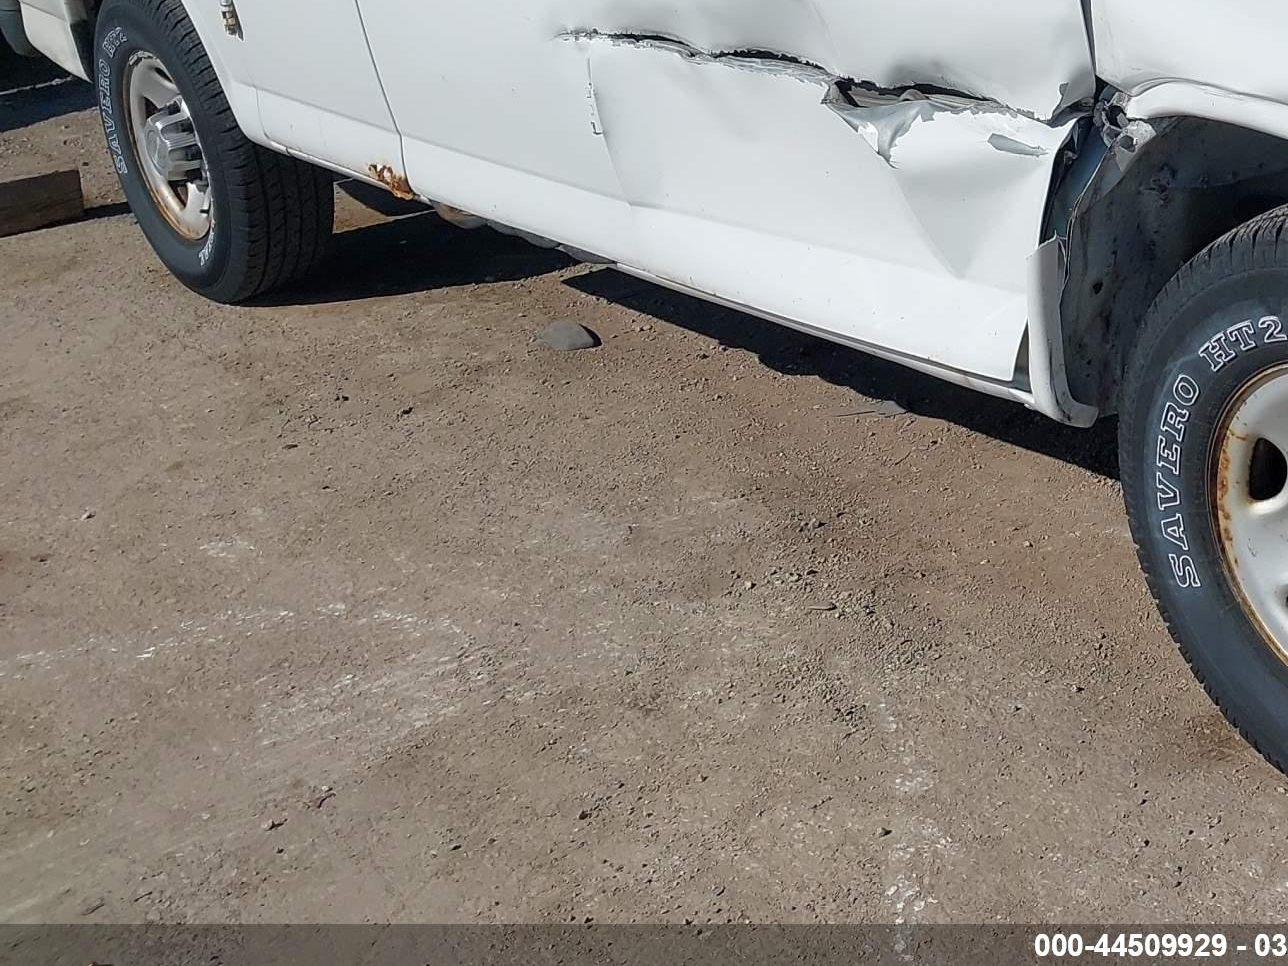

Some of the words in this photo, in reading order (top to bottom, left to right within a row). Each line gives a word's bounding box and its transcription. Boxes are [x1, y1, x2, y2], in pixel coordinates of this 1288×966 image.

[100, 58, 128, 175] SAVERO
[1156, 373, 1202, 589] SAVERO
[1198, 314, 1288, 373] HT2
